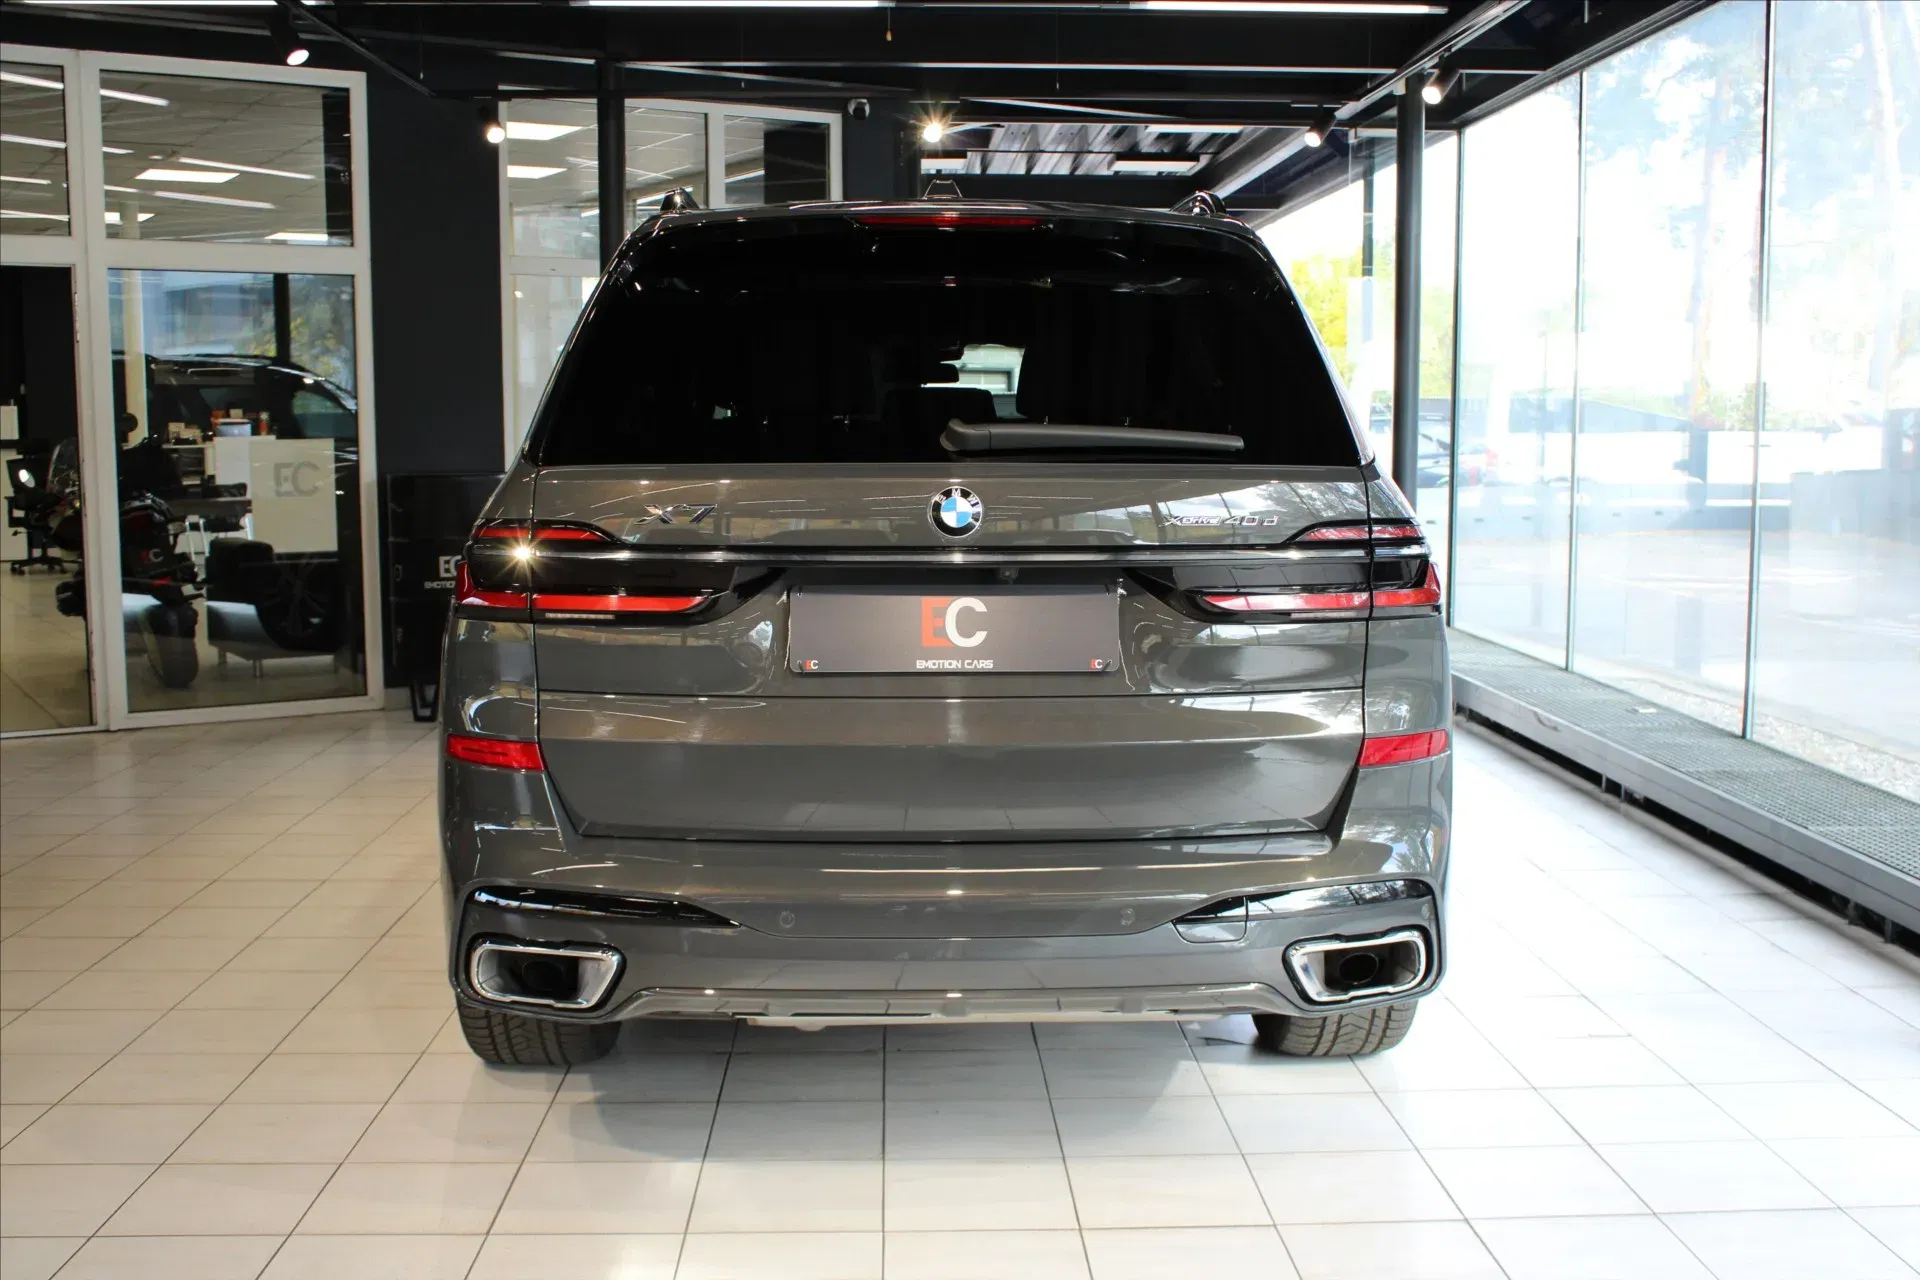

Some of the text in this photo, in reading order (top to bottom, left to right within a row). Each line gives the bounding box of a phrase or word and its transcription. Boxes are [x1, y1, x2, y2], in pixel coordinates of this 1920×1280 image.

[273, 461, 321, 497] EC
[634, 503, 718, 525] X7
[921, 596, 988, 648] EC
[805, 659, 819, 670] EC
[916, 660, 994, 669] EMOTION CARS
[1090, 658, 1103, 670] EC
